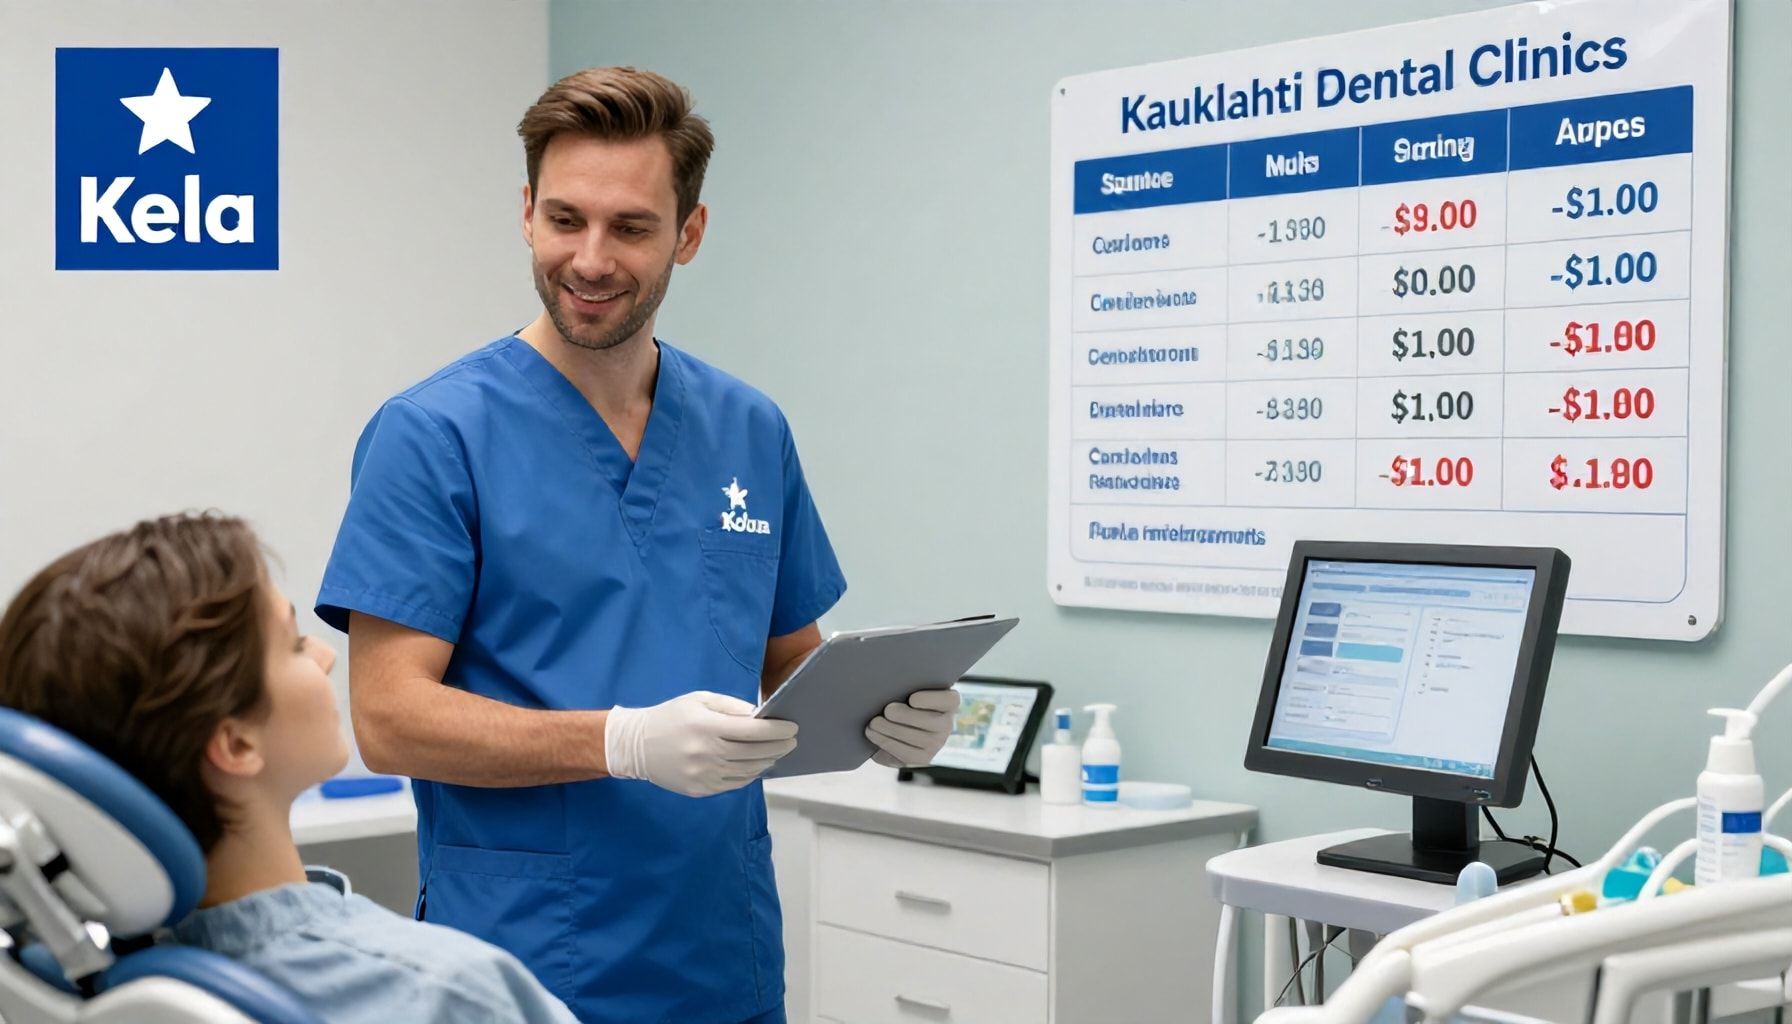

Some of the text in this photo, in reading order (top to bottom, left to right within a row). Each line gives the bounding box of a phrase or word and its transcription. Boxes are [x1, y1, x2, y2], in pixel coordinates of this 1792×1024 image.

[1121, 32, 1628, 134] Kauklahti Dental Clinics
[80, 174, 255, 244] Kela
[1552, 181, 1658, 219] -$1.00
[1392, 264, 1475, 298] $0.00
[1551, 251, 1657, 290] -$1.00
[1392, 328, 1474, 362] $1.00
[1391, 389, 1473, 424] $1.00
